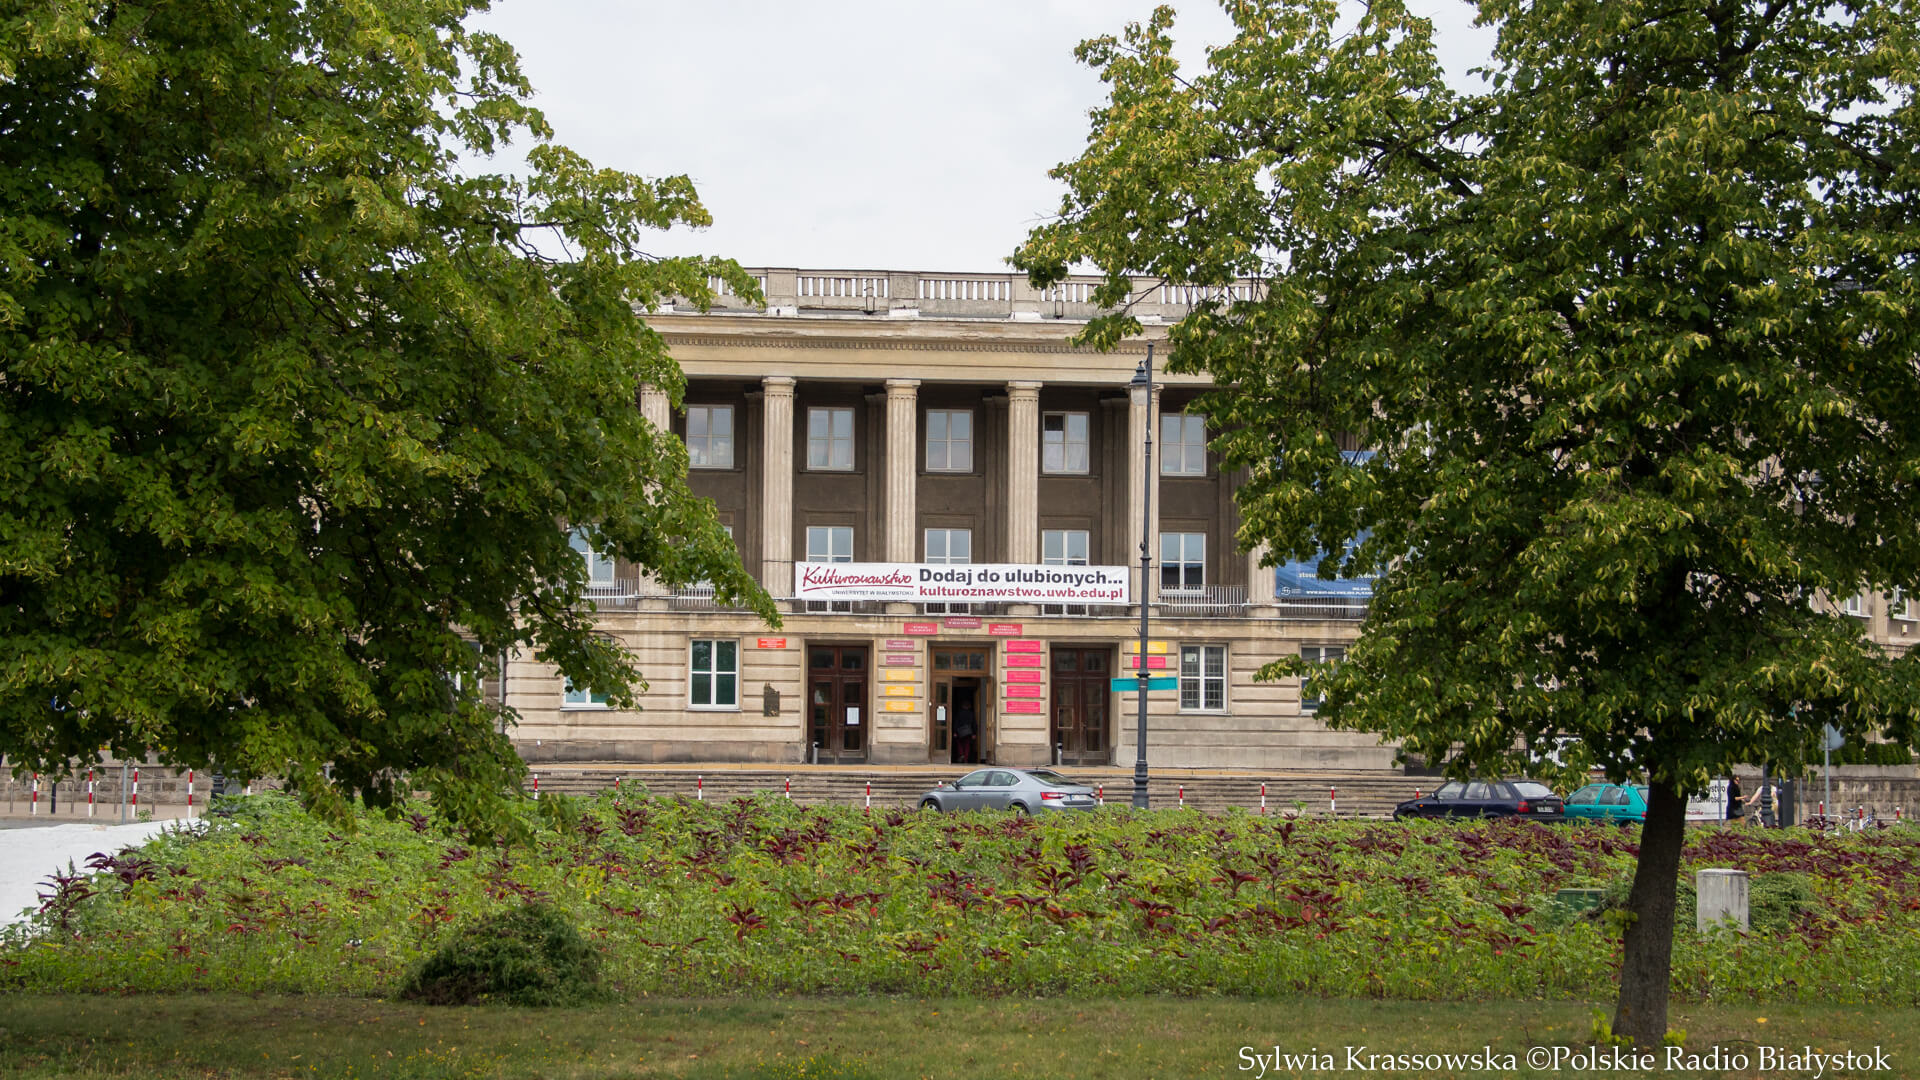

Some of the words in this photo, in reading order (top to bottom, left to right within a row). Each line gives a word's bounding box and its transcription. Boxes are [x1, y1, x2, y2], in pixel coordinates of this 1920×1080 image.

[803, 566, 912, 587] Kulturoznawstwo
[919, 569, 972, 586] Dodaj
[977, 569, 1000, 583] do
[1005, 569, 1123, 587] ulubionych...
[919, 585, 1123, 600] kulturoznawstwo.uwb.edu.pl
